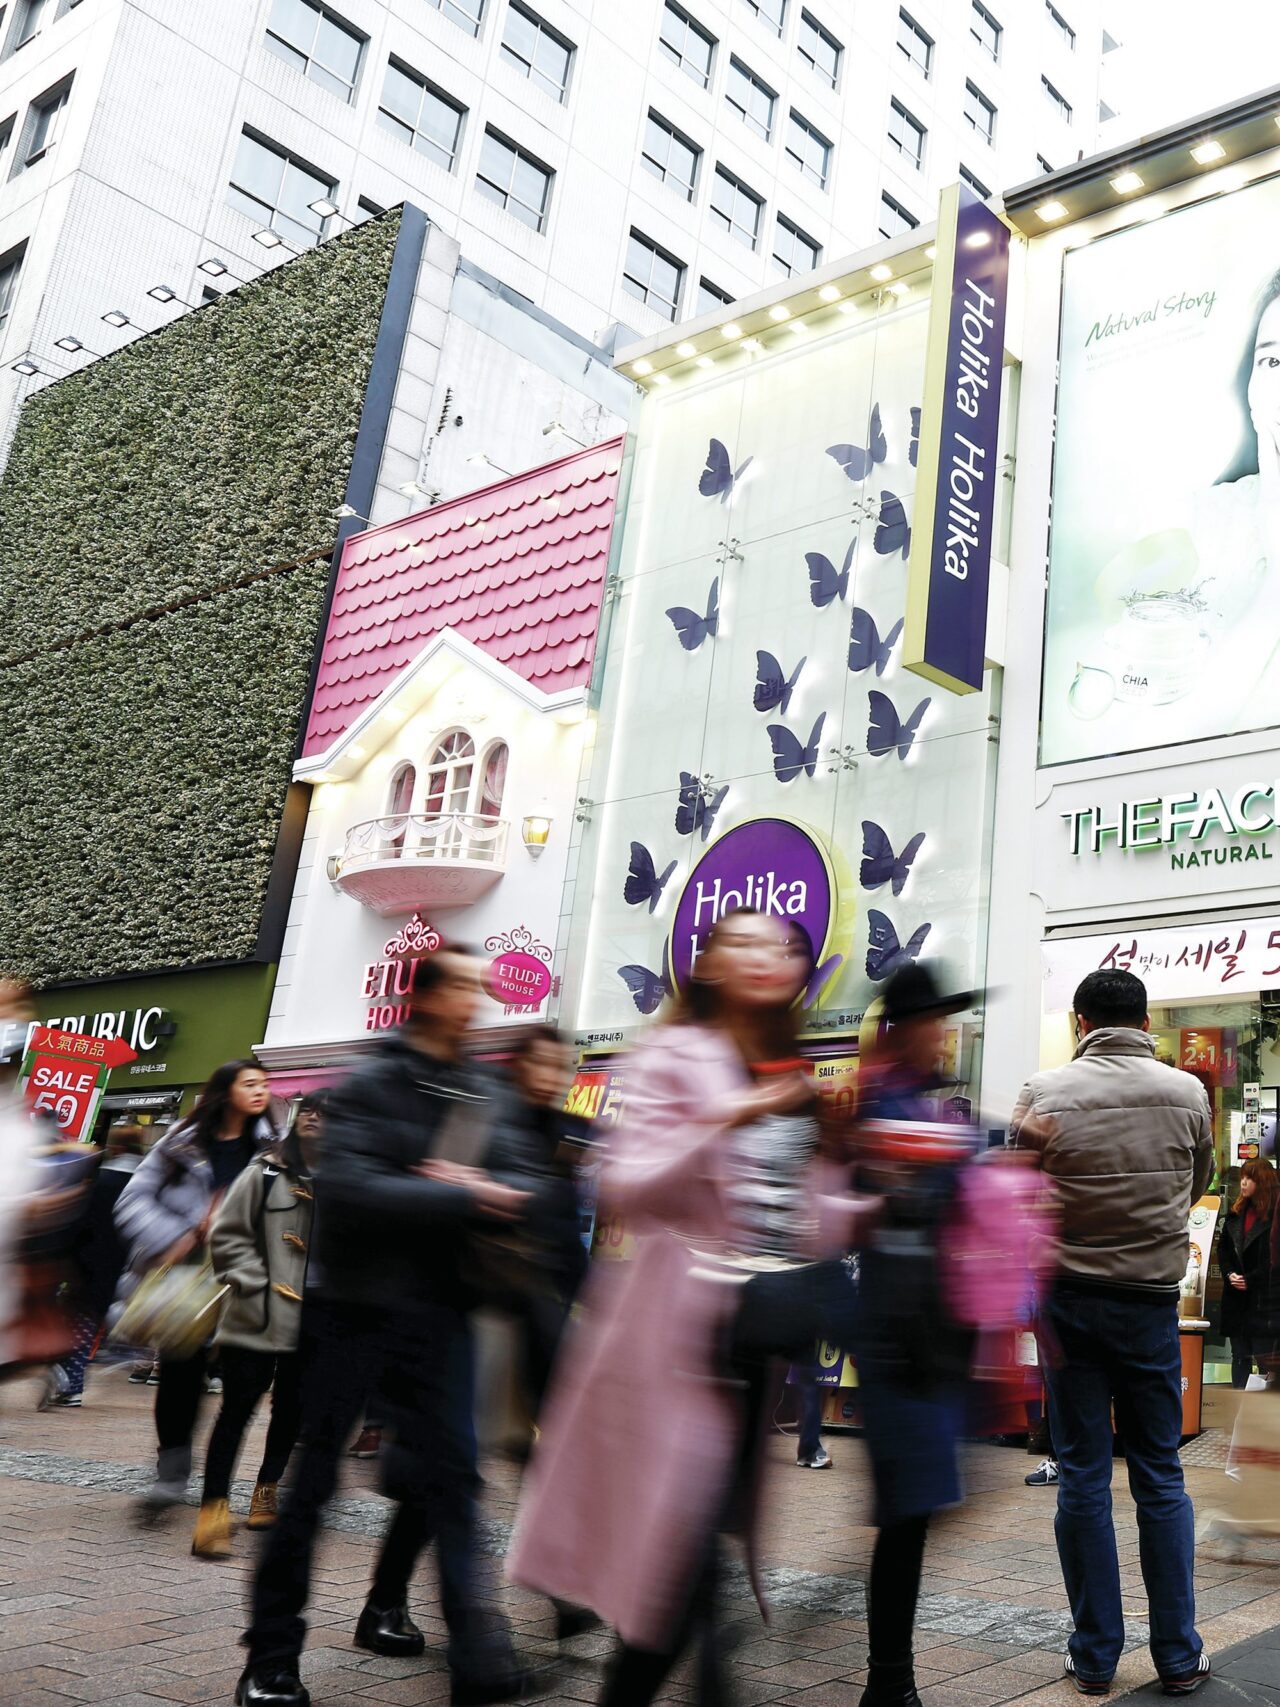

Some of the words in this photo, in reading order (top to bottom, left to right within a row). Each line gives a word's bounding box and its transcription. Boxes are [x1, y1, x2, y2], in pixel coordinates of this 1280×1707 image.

[1085, 299, 1161, 348] Natural
[1163, 290, 1217, 319] Story
[957, 277, 996, 419] Holika
[944, 430, 986, 582] Holika
[1122, 674, 1149, 687] CHIA
[1171, 840, 1273, 870] NATURAL
[694, 871, 808, 927] Holika
[359, 956, 418, 999] ETU
[498, 962, 544, 987] ETUDE
[501, 981, 535, 997] HOUSE
[364, 1003, 413, 1031] HOU
[39, 1032, 105, 1058] 人氣商品
[1184, 1044, 1217, 1067] 2+1
[33, 1067, 94, 1094] SALE
[818, 1065, 835, 1078] SALE
